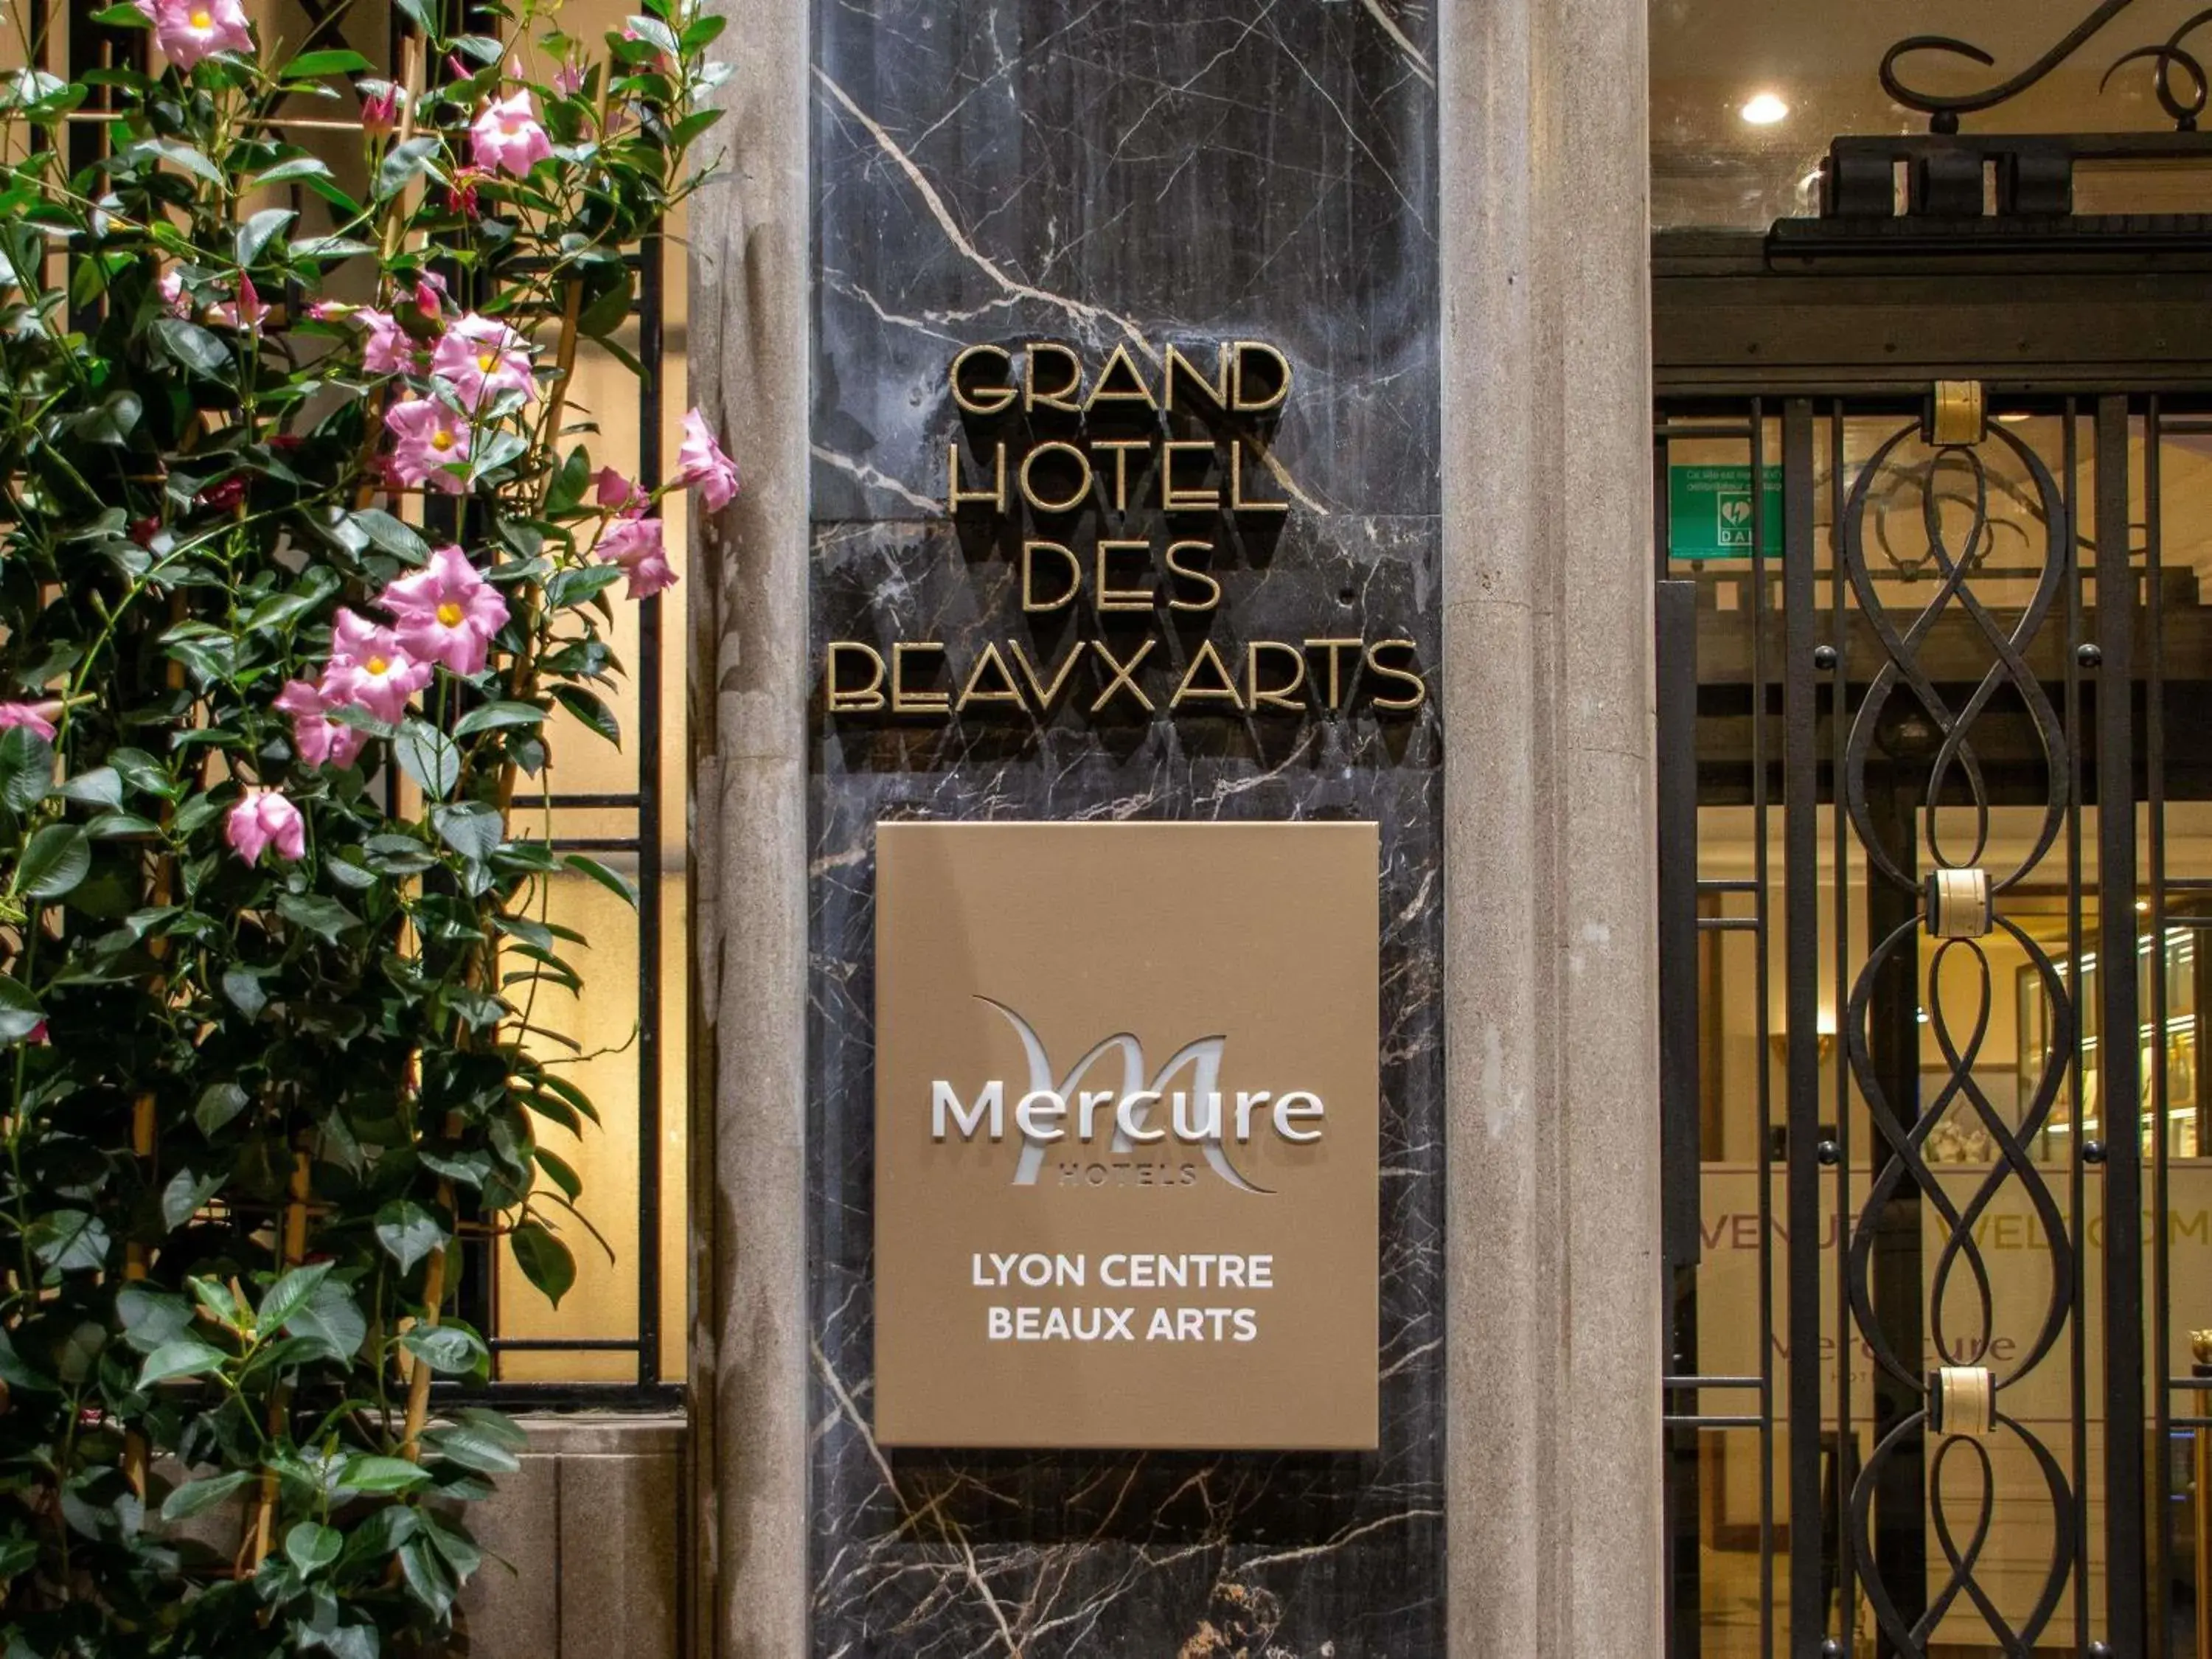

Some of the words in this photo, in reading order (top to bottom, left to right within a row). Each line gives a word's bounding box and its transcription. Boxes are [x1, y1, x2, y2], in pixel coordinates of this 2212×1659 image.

[949, 341, 1293, 414] GRAND
[948, 440, 1289, 514] HOTEL
[1022, 540, 1222, 611] DES
[1169, 638, 1426, 712] ARTS
[931, 1079, 1325, 1143] Mercure
[1058, 1162, 1197, 1186] HOTELS
[972, 1253, 1085, 1287] LYON
[1099, 1253, 1274, 1288] CENTRE
[988, 1307, 1135, 1340] BEAUX
[1146, 1307, 1258, 1341] ARTS
